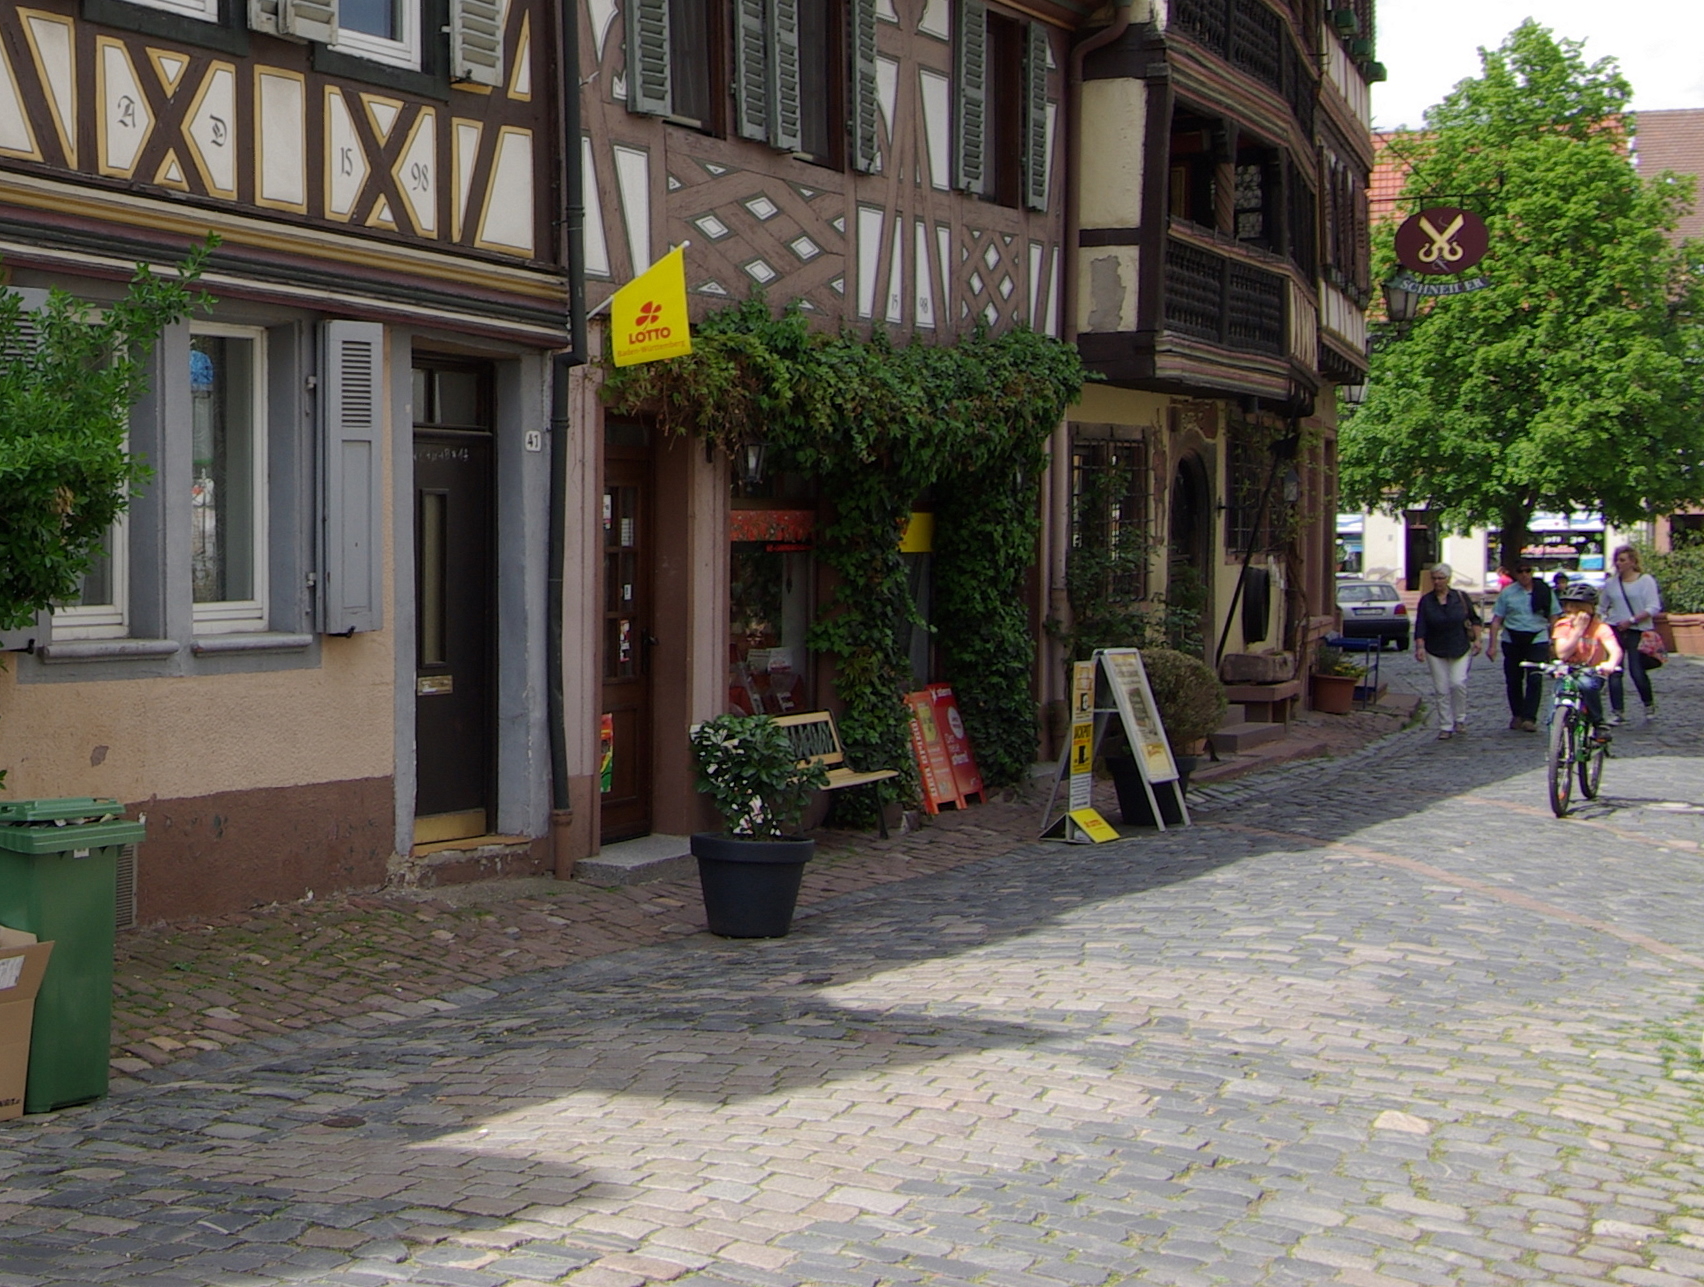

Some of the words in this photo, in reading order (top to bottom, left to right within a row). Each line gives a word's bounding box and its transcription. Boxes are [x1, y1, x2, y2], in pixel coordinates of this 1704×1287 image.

[340, 147, 353, 177] 15
[411, 162, 429, 192] 98
[629, 326, 672, 345] LOTTO
[527, 433, 539, 449] 41
